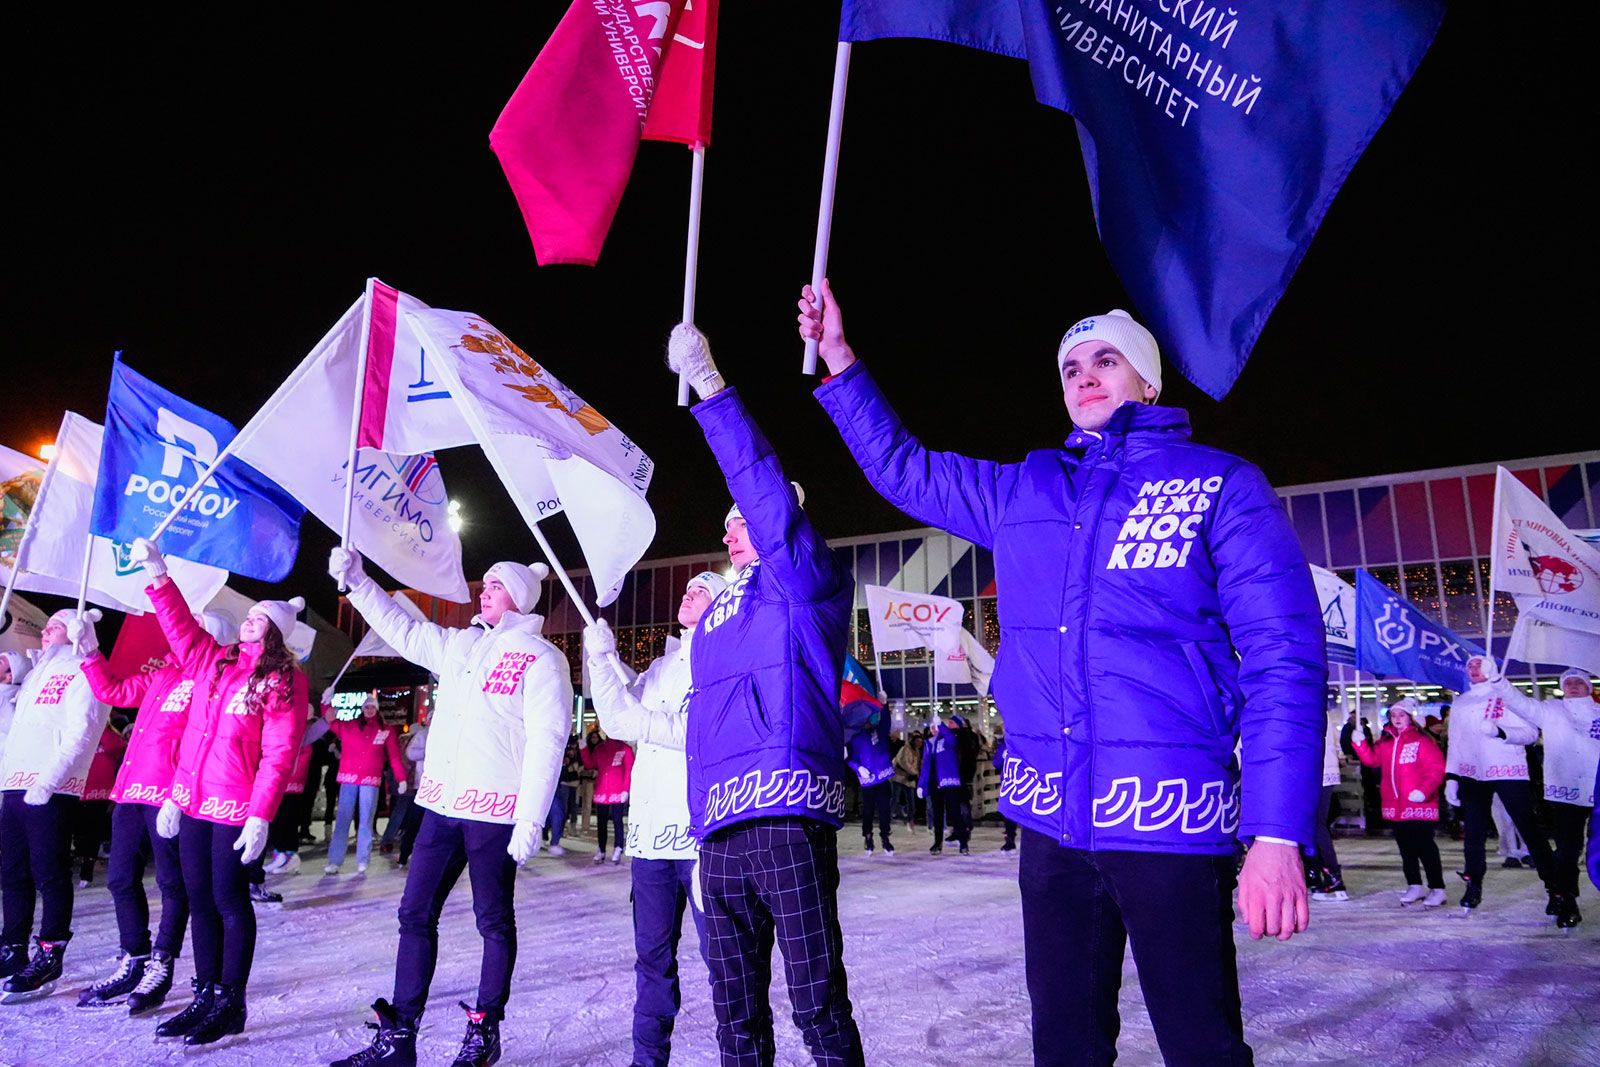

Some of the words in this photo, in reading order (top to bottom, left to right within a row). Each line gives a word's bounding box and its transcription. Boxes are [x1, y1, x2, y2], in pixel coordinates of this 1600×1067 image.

[1056, 7, 1199, 127] ИВЕРСИТЕТ
[342, 451, 433, 542] МГИМО
[1137, 475, 1224, 498] МОЛО
[331, 473, 426, 557] УИВЕРСИТЕТ
[1128, 493, 1211, 516] ДЕЖЬ
[1116, 514, 1204, 541] МОС
[1105, 541, 1193, 570] КВЫ
[482, 681, 517, 696] КВЫ
[488, 669, 523, 682] МОС
